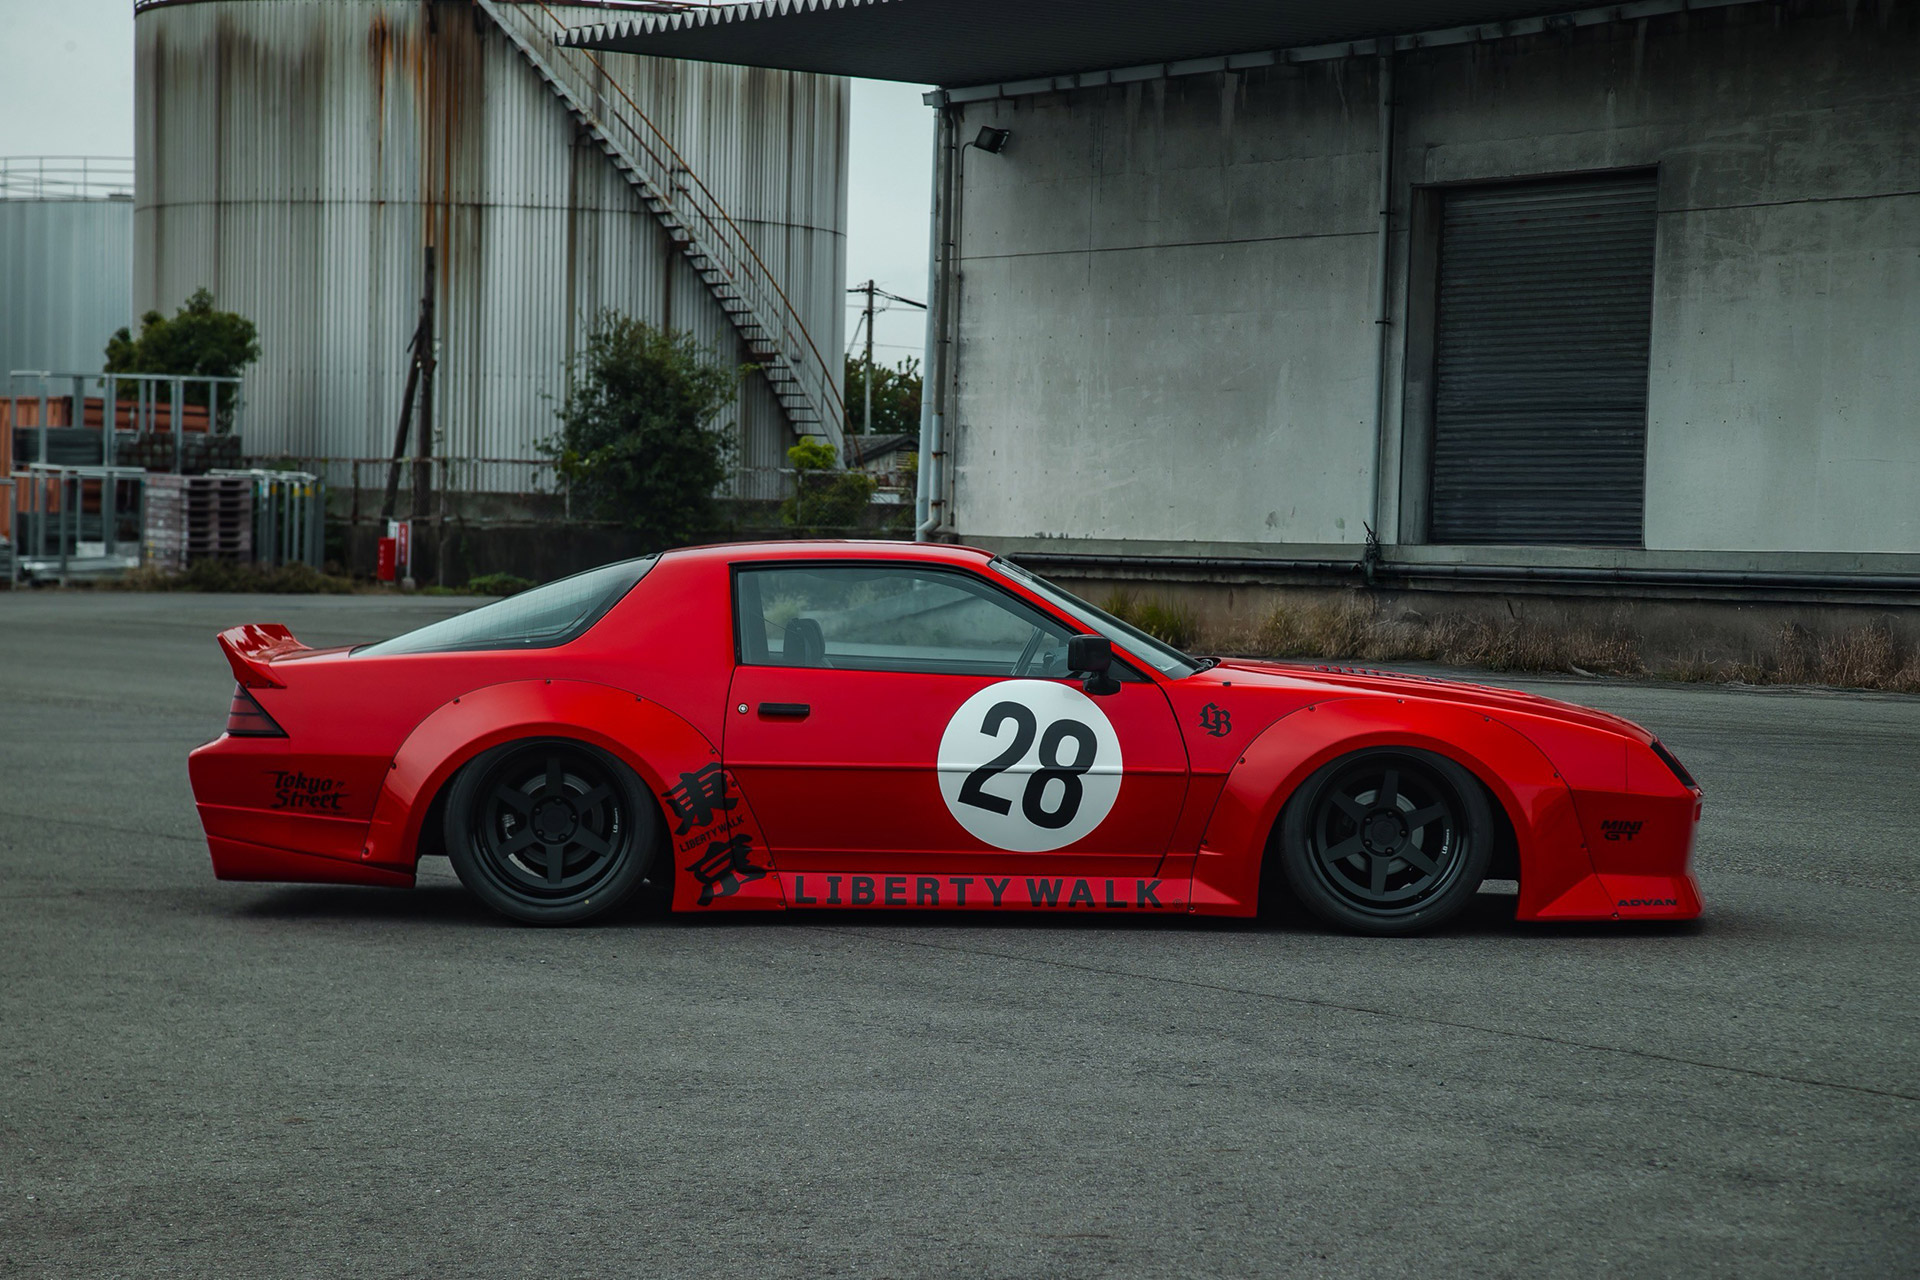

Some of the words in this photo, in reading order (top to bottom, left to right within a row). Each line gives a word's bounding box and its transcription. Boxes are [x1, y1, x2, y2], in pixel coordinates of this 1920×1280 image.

[957, 700, 1098, 829] 28
[262, 770, 334, 794] Tokyo
[270, 788, 351, 809] Street
[679, 827, 718, 853] LIBERTY
[718, 814, 745, 834] WALK
[1600, 819, 1644, 831] MINI
[1603, 831, 1640, 841] GT
[795, 875, 1011, 907] LIBERTY
[1026, 878, 1163, 908] WALK
[1617, 898, 1678, 906] ADVAN
